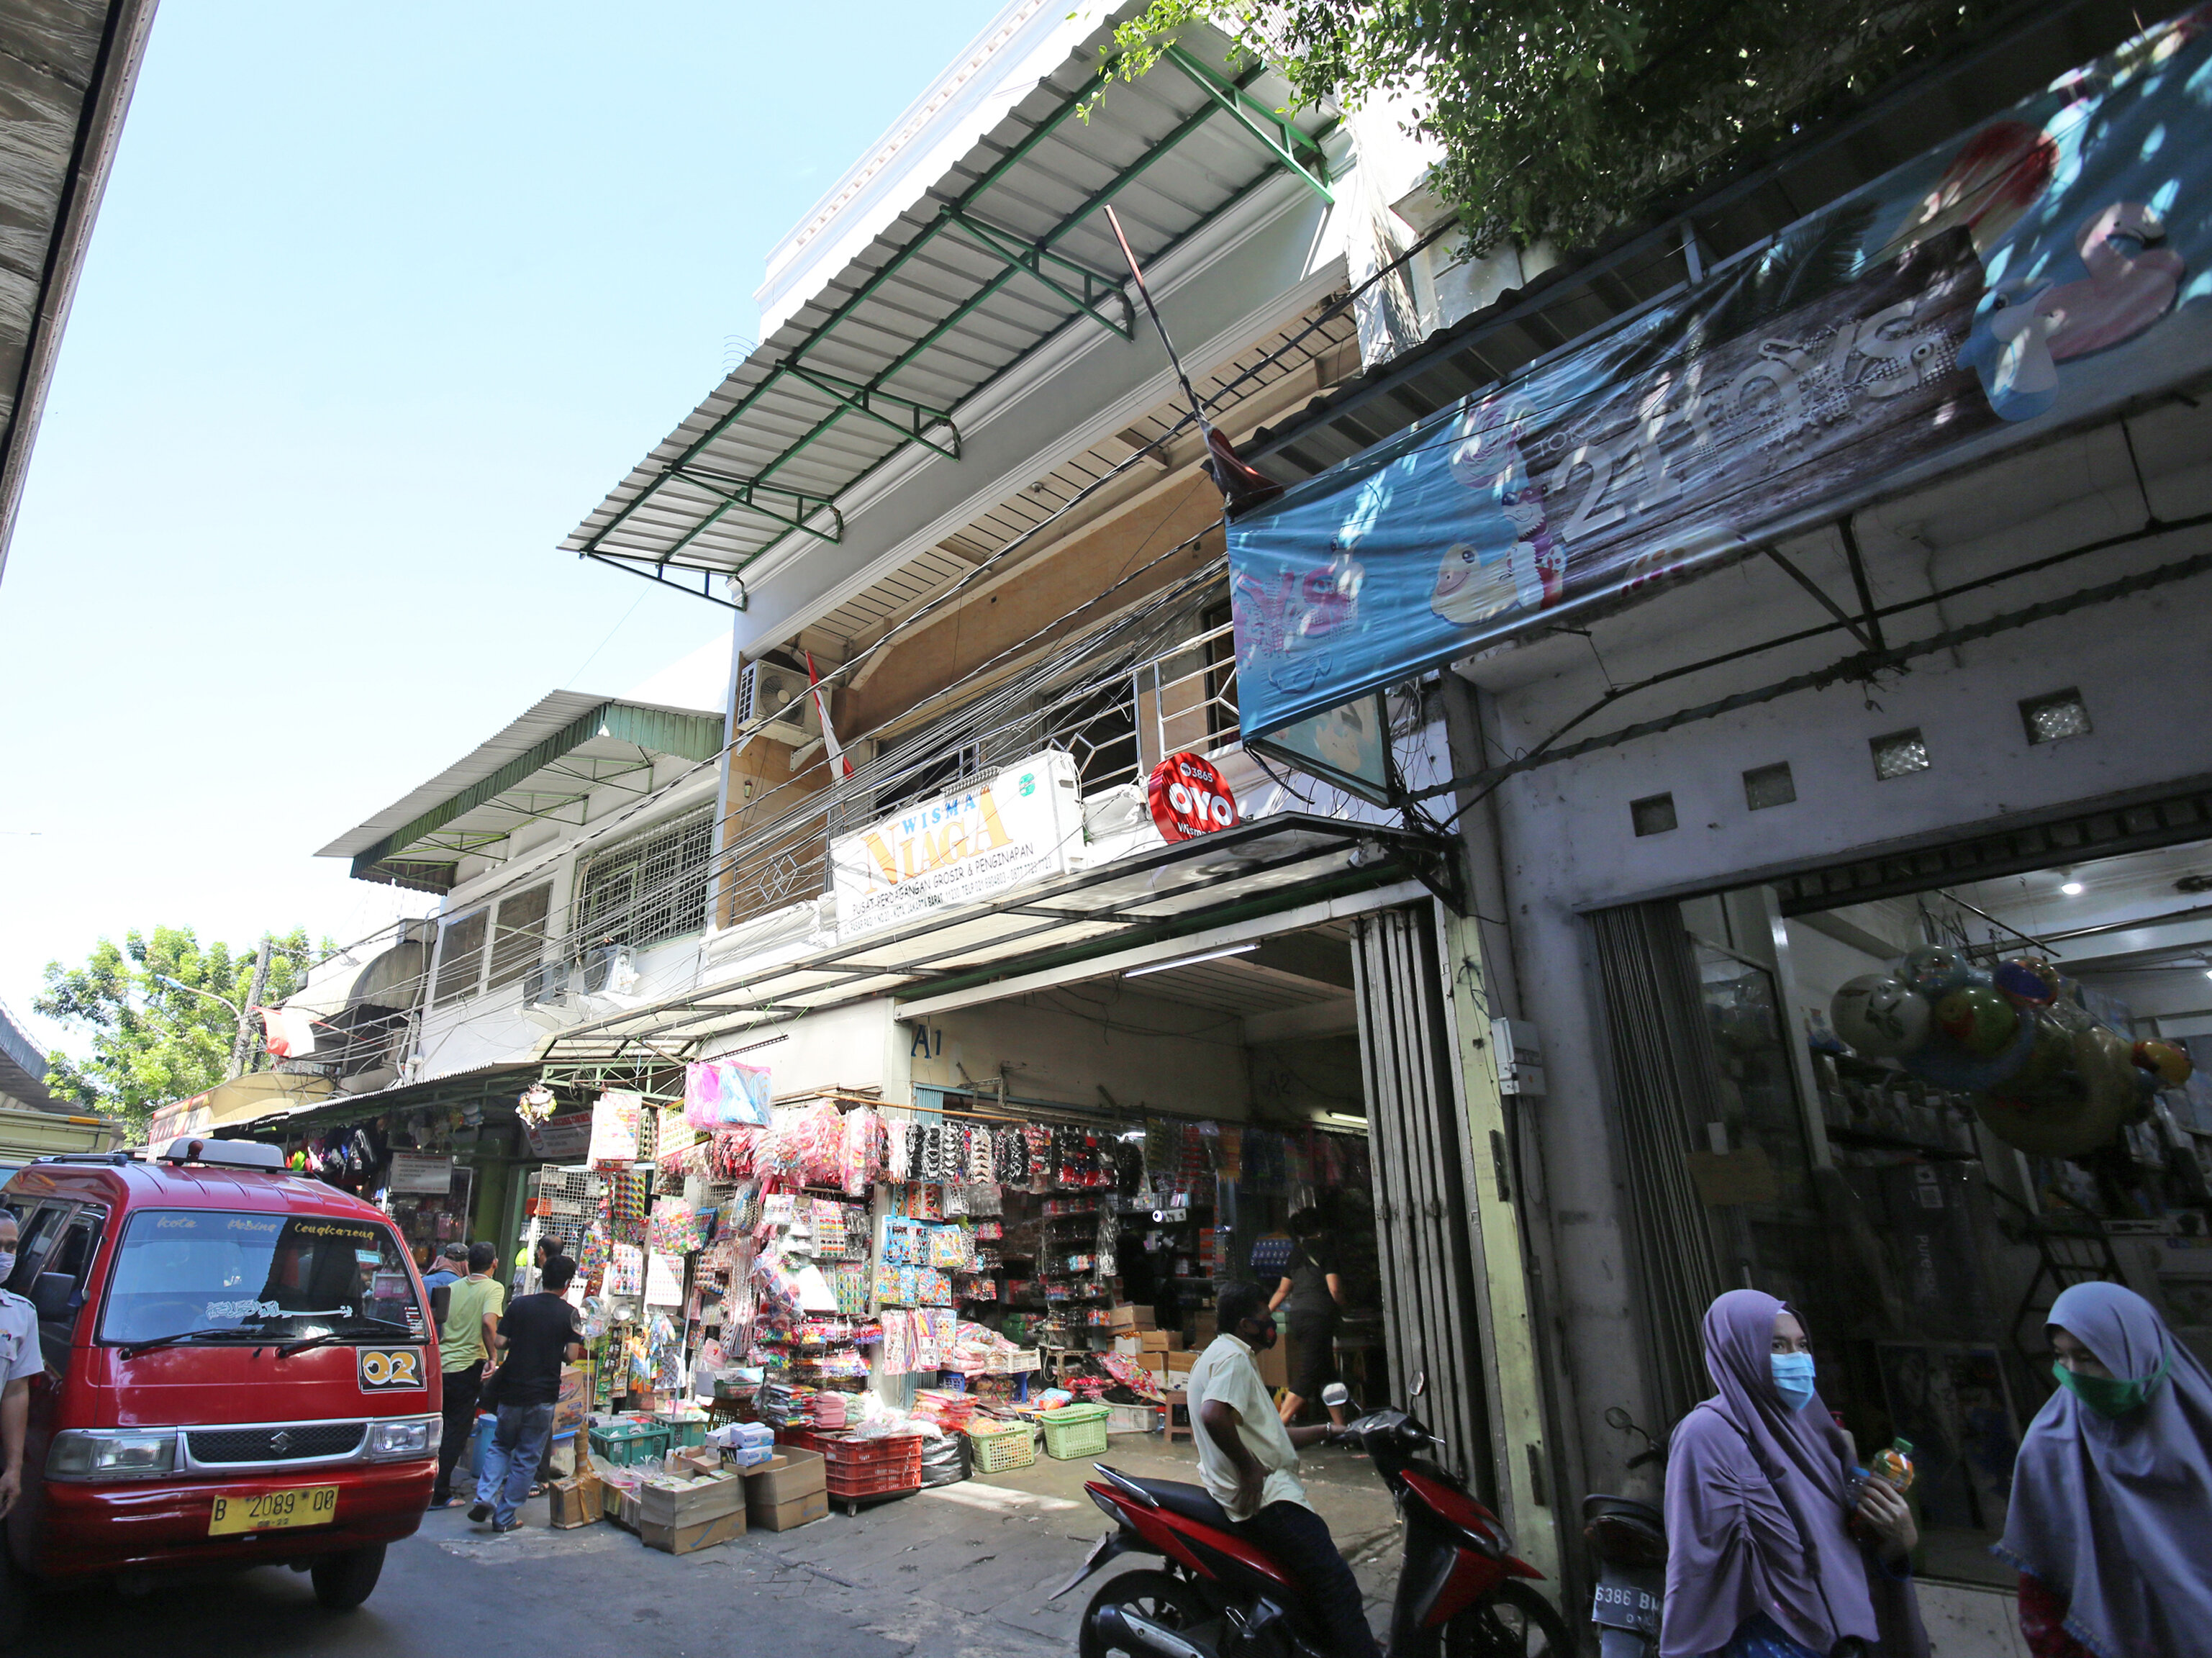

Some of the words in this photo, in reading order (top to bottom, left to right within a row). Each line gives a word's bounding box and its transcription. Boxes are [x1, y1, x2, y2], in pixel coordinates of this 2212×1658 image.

[1536, 413, 1603, 458] TOKO
[1192, 767, 1214, 782] 3865
[902, 794, 976, 835] WISMA
[1169, 782, 1233, 826] OYO
[861, 785, 1013, 895] NIAGA
[933, 869, 964, 889] GROSIR
[966, 861, 974, 877] &
[974, 842, 1034, 874] PENGINAPAN
[927, 892, 943, 909] BARAT
[911, 1024, 941, 1059] A1
[214, 1499, 227, 1521] B
[250, 1492, 295, 1517] 2089
[1595, 1587, 1632, 1606] 6386
